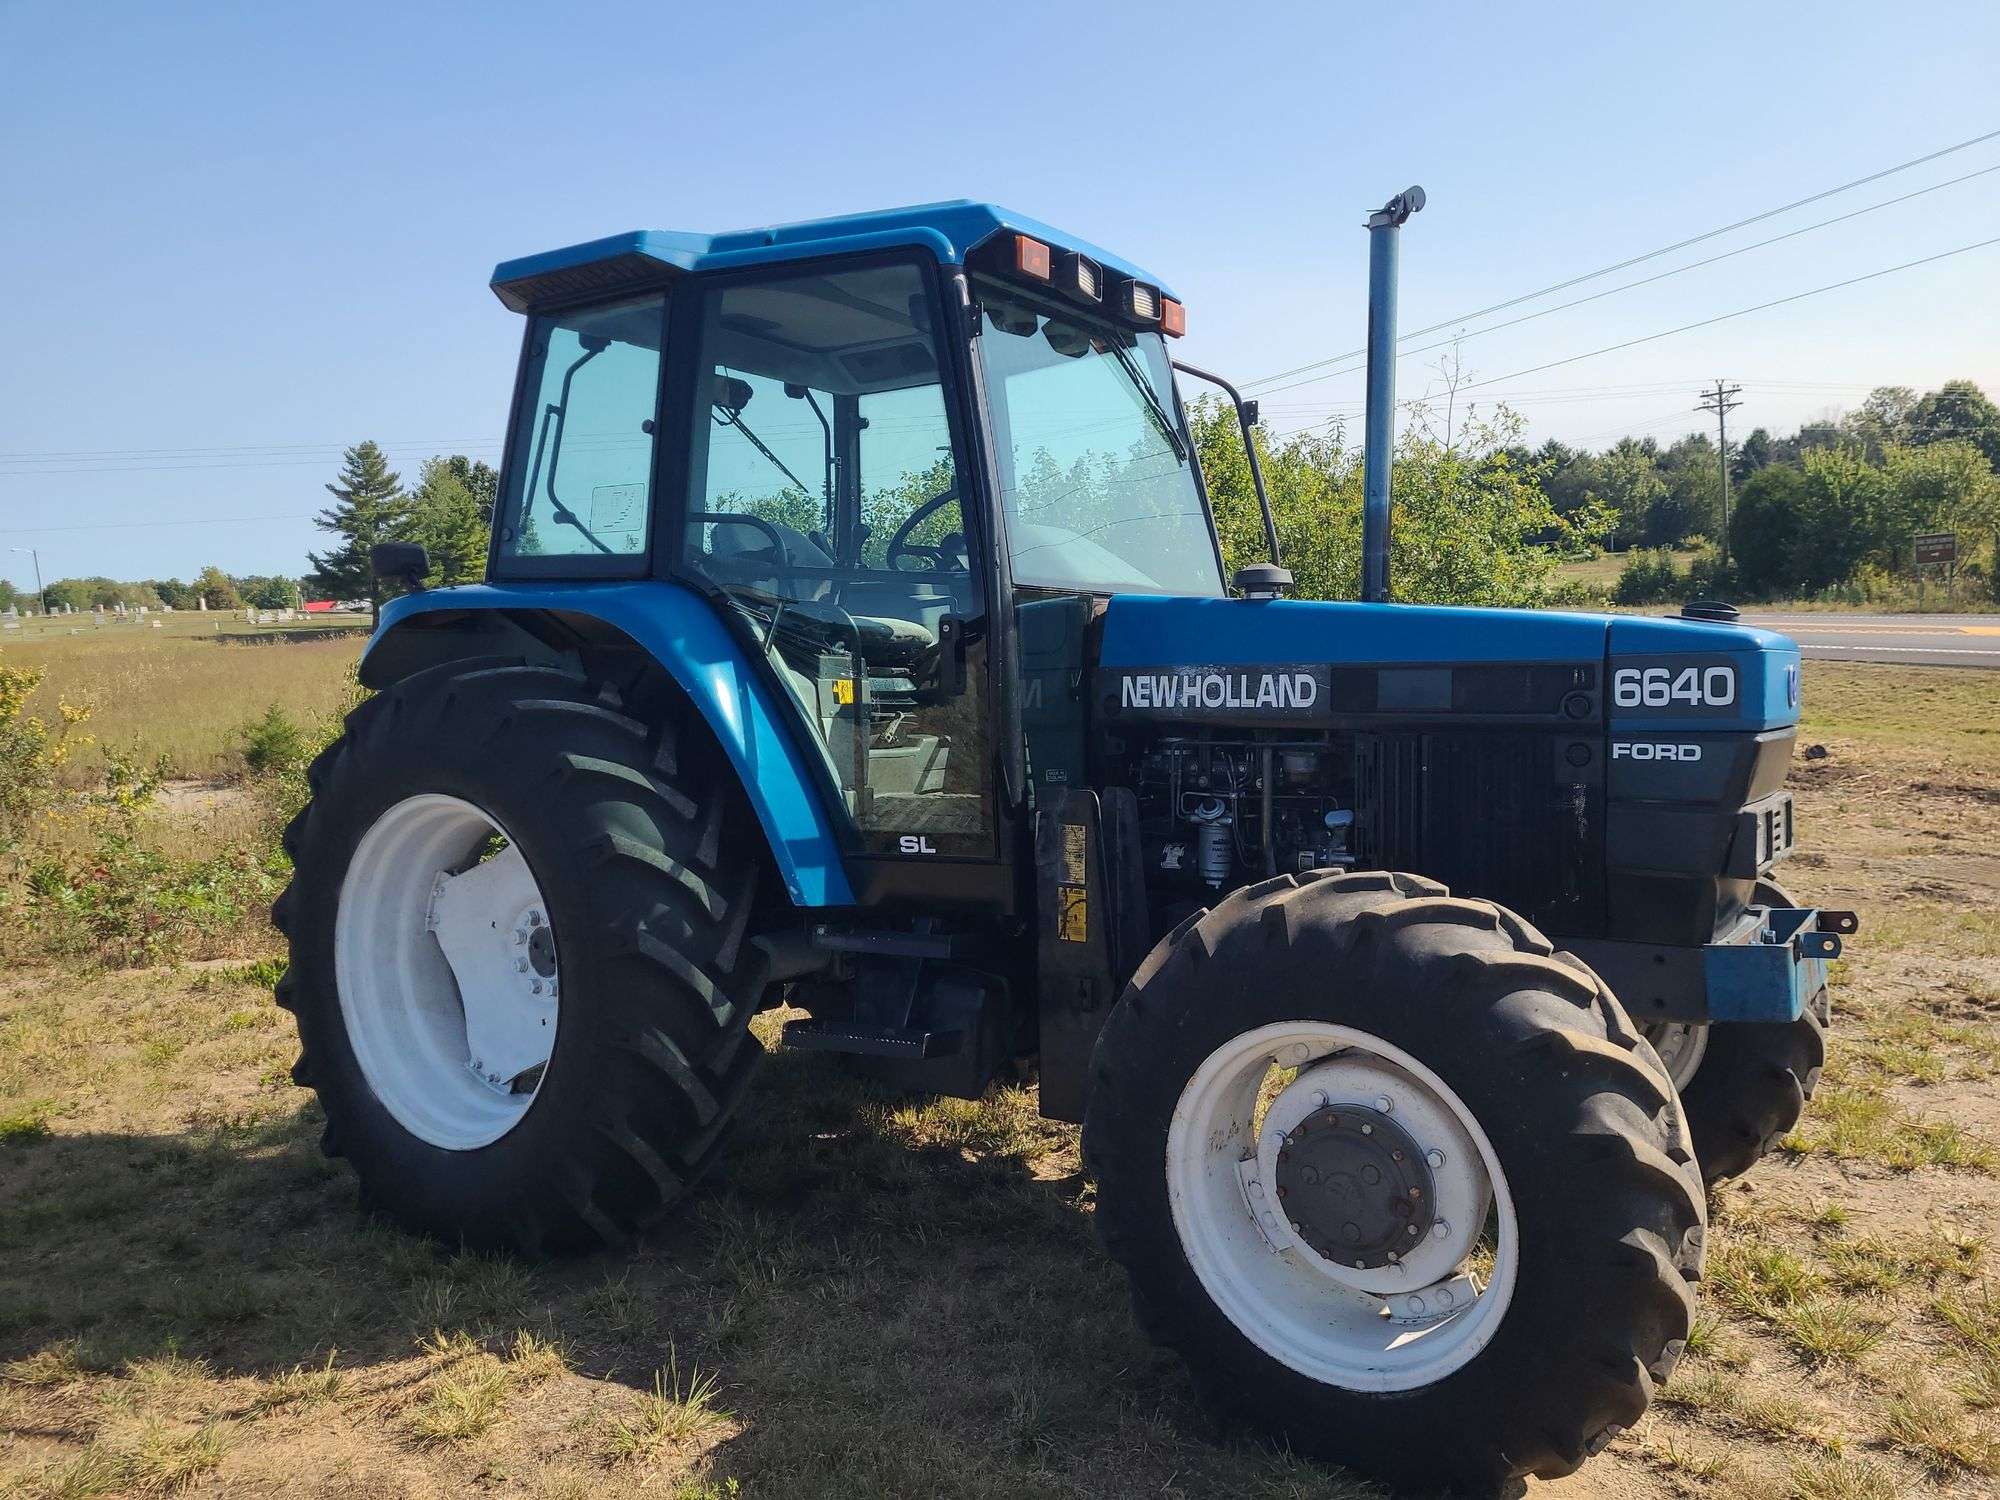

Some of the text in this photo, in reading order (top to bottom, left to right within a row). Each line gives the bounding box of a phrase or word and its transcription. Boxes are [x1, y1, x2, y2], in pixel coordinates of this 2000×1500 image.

[1122, 674, 1317, 708] NEW HOLLAND
[1614, 666, 1735, 707] 6640
[1612, 743, 1702, 761] FORD
[900, 835, 936, 854] SL
